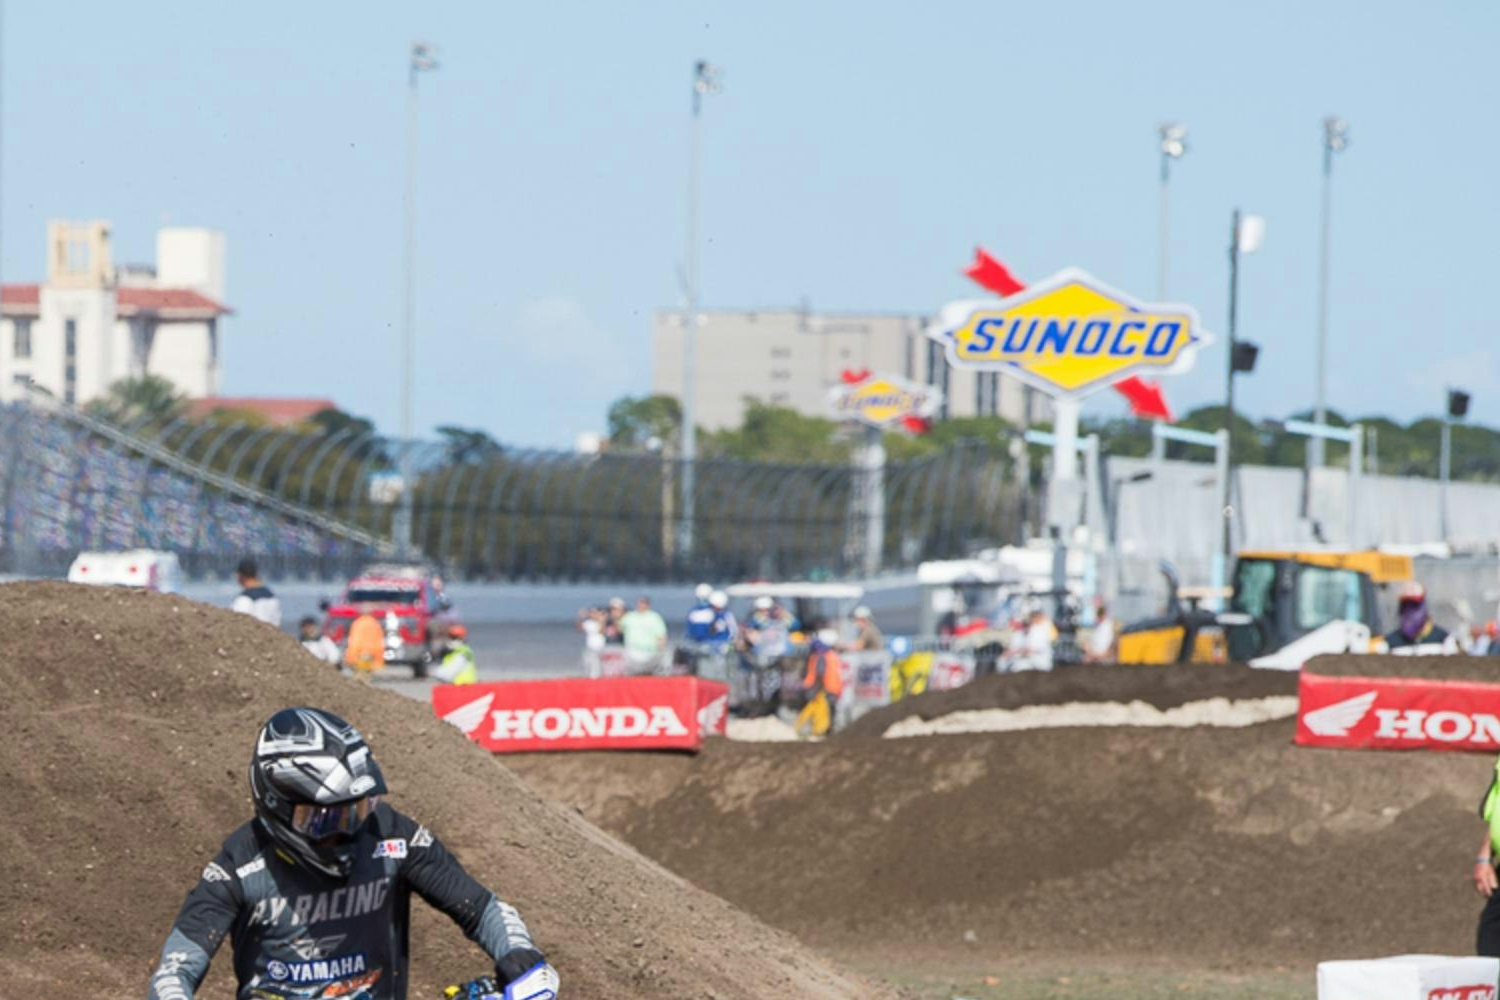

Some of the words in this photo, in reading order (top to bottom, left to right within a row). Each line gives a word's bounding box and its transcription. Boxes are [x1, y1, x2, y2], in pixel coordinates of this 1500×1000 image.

[966, 318, 1182, 357] SUNOCO
[490, 706, 688, 740] HONDA
[291, 878, 391, 926] RACING
[288, 955, 367, 983] YAMAHA
